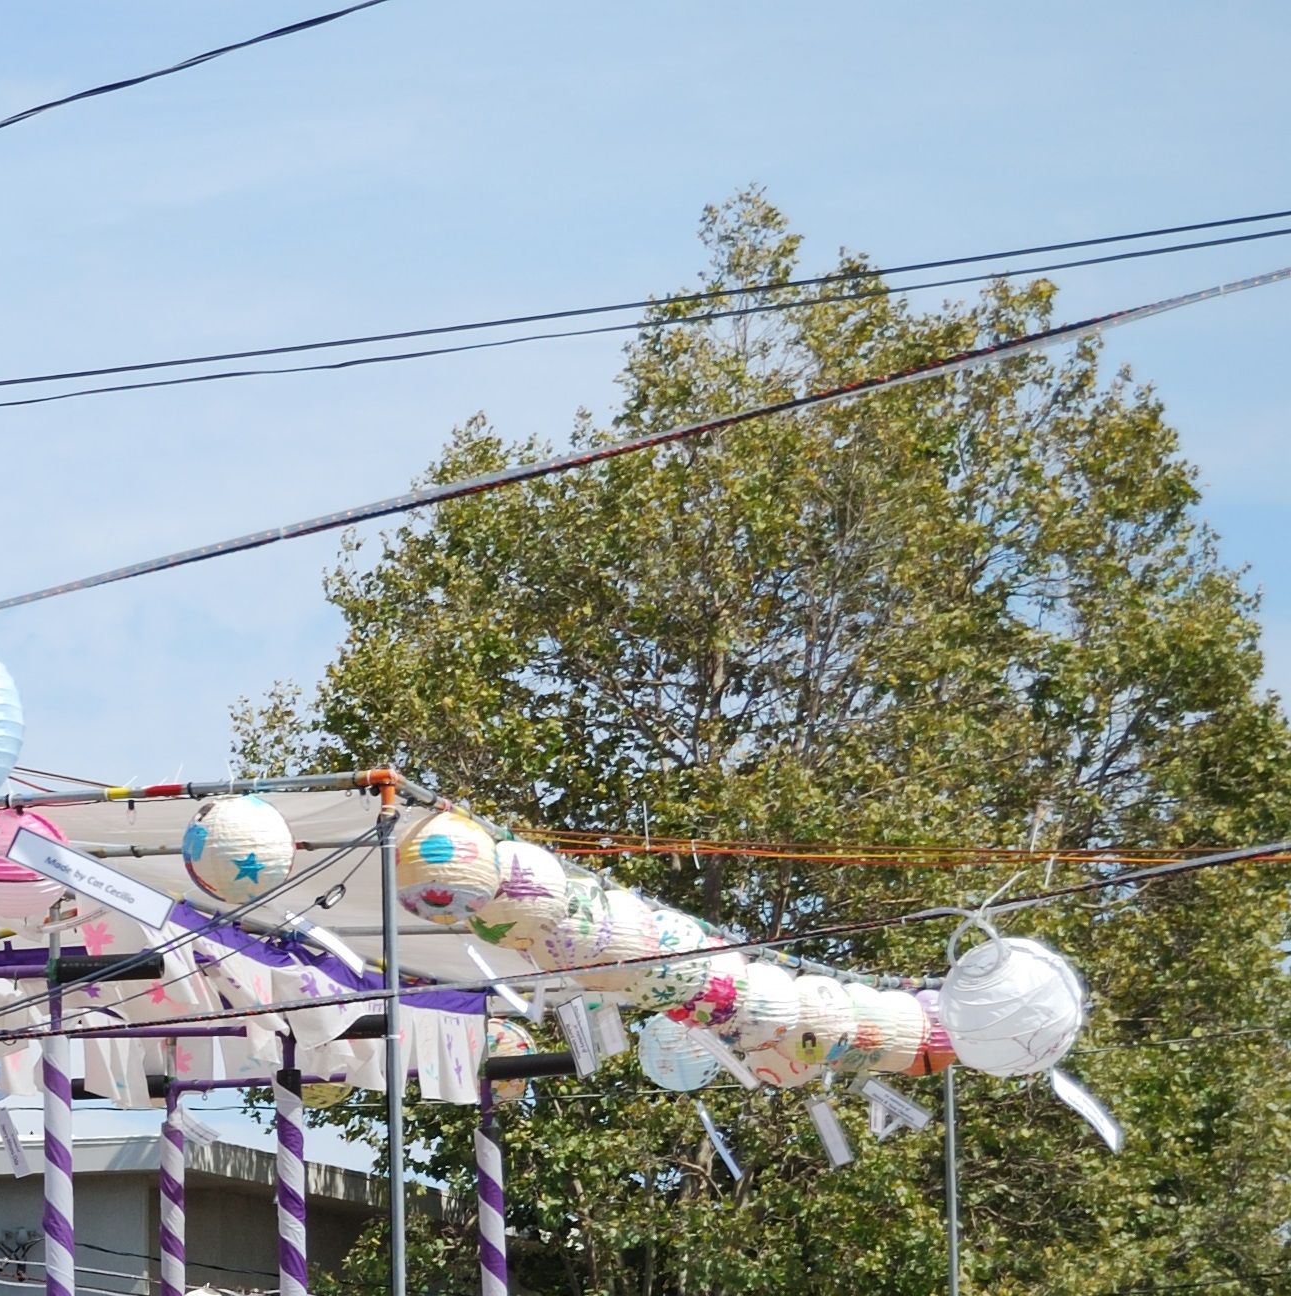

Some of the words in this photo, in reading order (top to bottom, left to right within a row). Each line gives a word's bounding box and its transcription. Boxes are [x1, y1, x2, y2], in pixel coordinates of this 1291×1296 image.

[45, 856, 73, 874] Made
[73, 869, 86, 881] by
[87, 876, 104, 890] Cat
